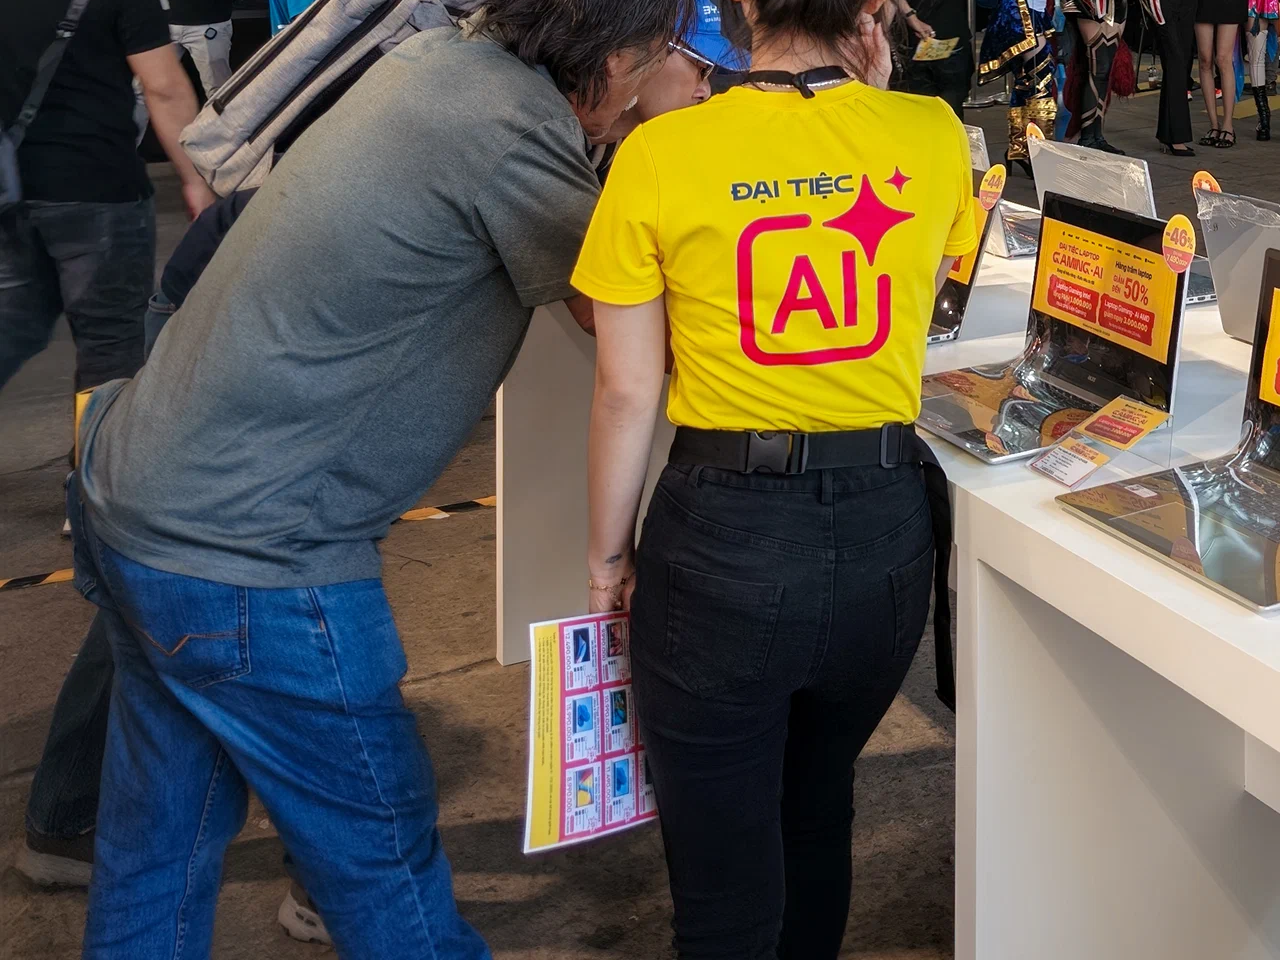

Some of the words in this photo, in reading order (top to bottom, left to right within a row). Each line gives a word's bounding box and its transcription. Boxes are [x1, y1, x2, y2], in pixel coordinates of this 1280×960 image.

[731, 179, 779, 204] ĐẠI
[787, 172, 854, 201] TIỆC
[1166, 227, 1193, 249] -46%
[1080, 248, 1100, 260] LAPTOP
[1115, 261, 1127, 273] Hàng
[1138, 268, 1152, 280] laptop
[770, 250, 858, 335] AI
[1124, 277, 1148, 305] 50%
